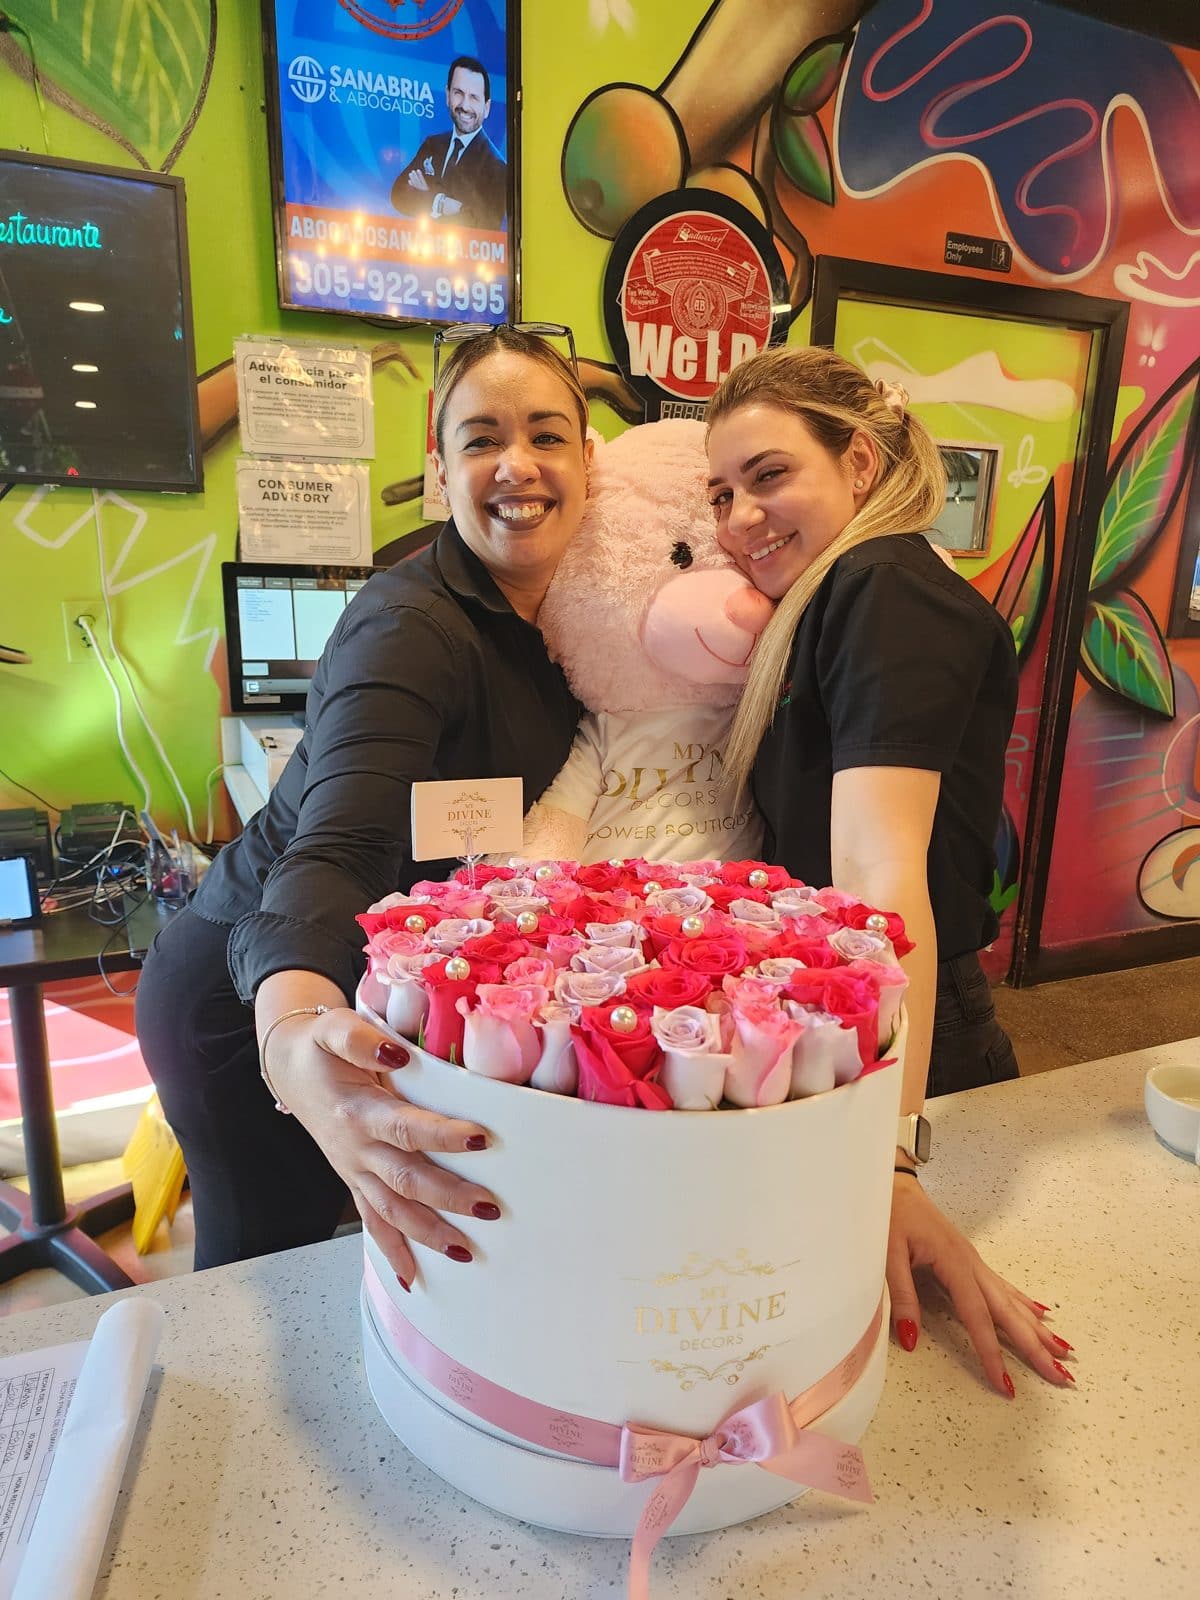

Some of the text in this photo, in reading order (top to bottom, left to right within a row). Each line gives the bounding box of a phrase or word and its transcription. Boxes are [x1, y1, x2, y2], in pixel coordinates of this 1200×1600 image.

[329, 65, 435, 104] SANABRIA
[329, 86, 435, 119] & ABOGADOS
[947, 240, 984, 254] Employees
[946, 251, 962, 263] Only
[295, 261, 505, 315] 305-922-9995
[627, 321, 698, 382] We
[249, 361, 324, 377] Advercia
[260, 375, 271, 384] el
[258, 479, 333, 492] CONSUMER
[262, 491, 330, 503] ADVISORY
[448, 808, 492, 822] DIVINE
[634, 1291, 787, 1335] DIVINE
[679, 1335, 744, 1351] DECORS
